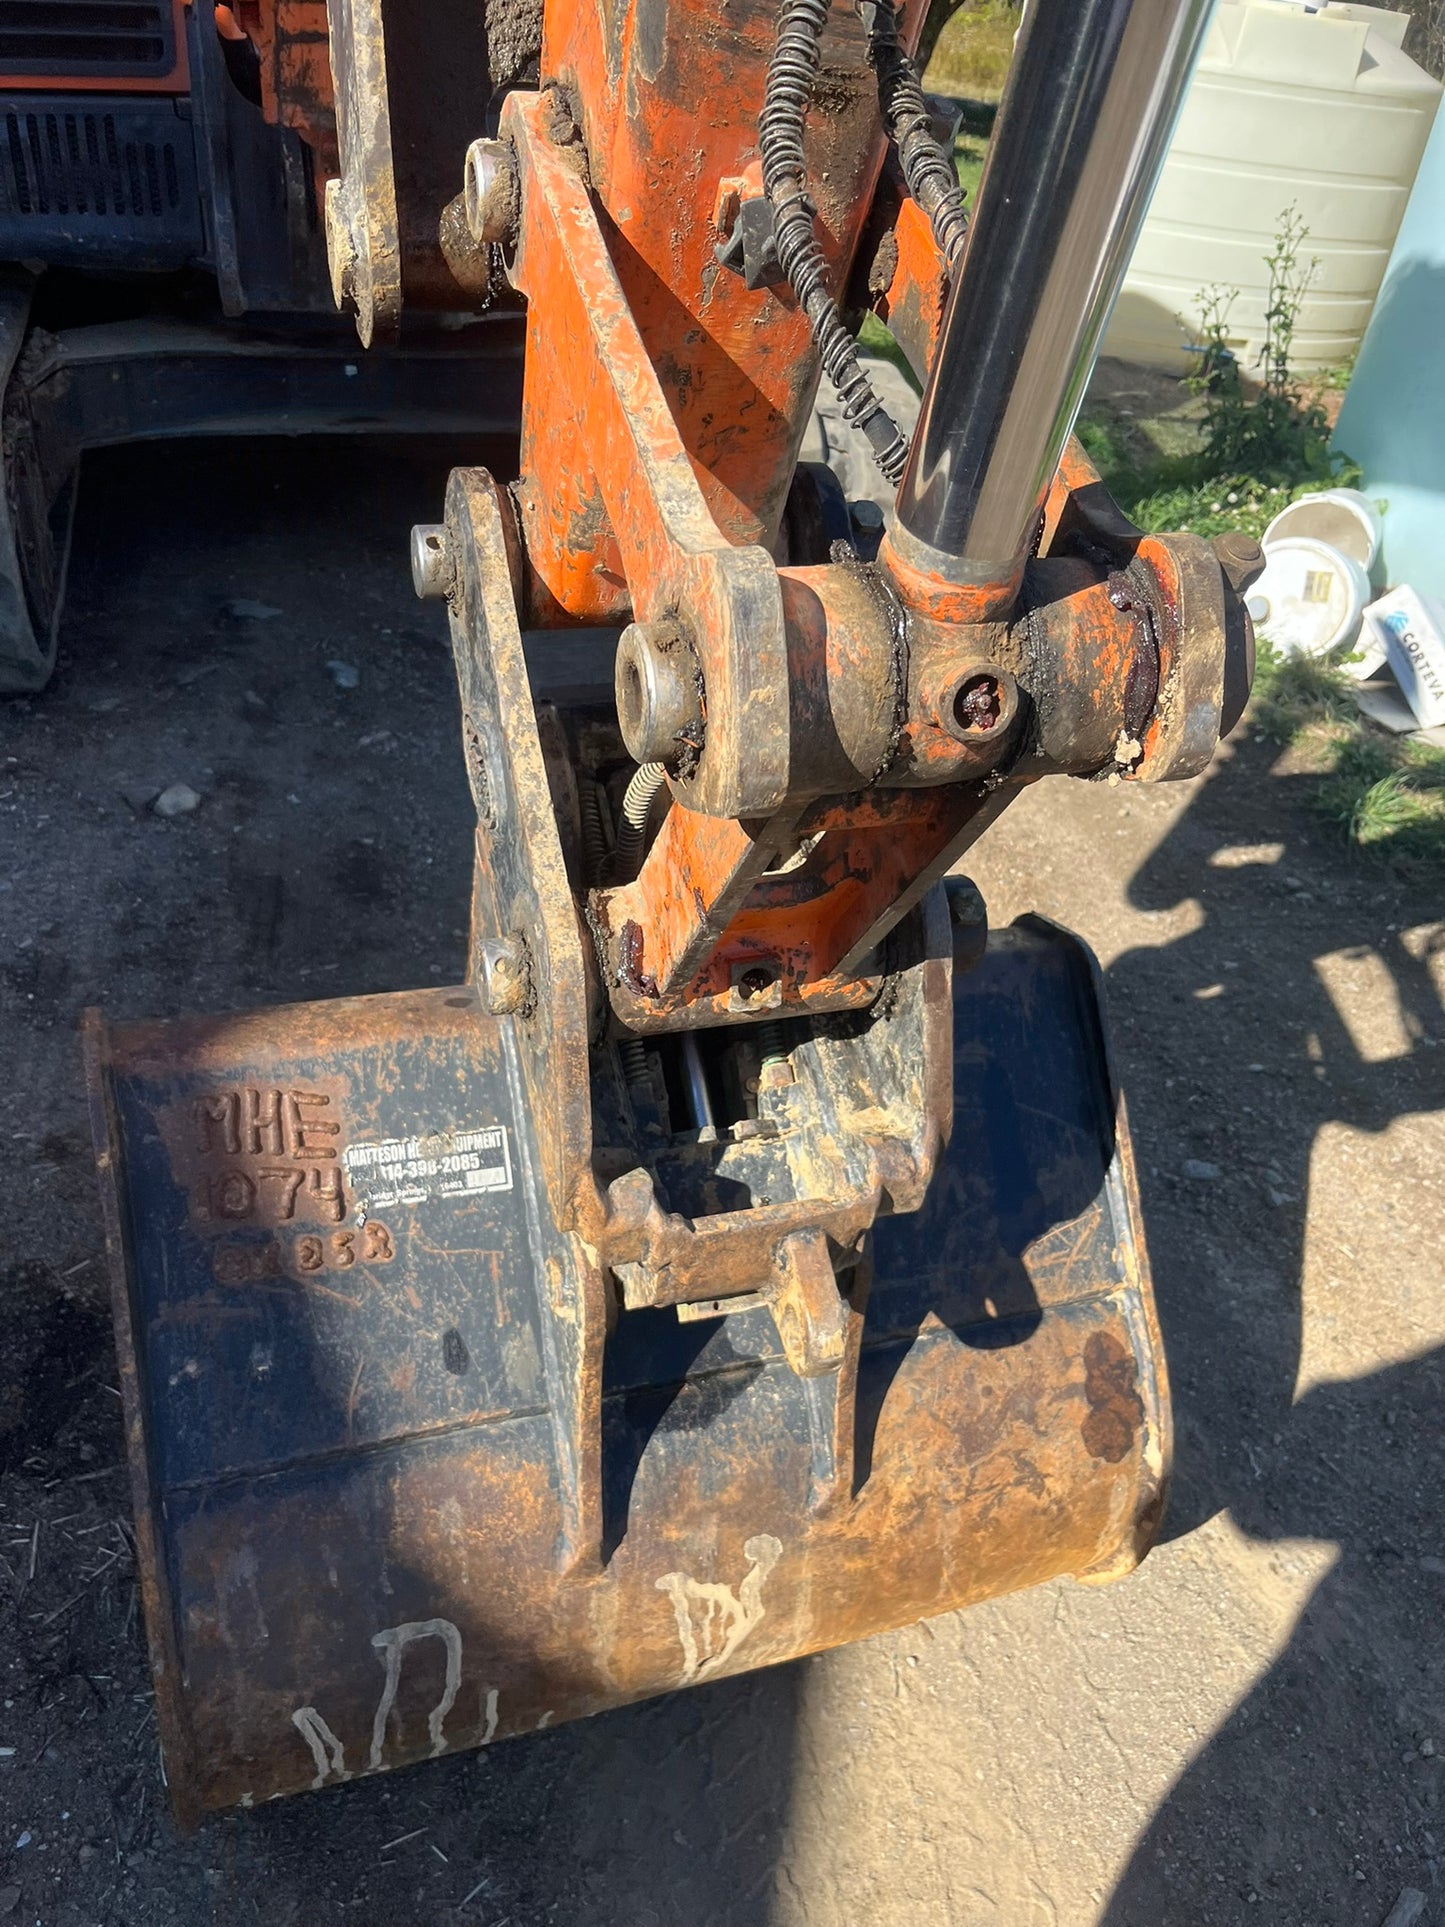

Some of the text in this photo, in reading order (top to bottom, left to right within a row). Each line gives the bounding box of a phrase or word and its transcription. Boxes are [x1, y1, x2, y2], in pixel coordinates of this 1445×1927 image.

[1403, 632, 1445, 701] CORTEVA
[195, 1088, 341, 1159] MHE
[348, 1143, 406, 1167] MATTESON
[196, 1166, 346, 1222] 1074
